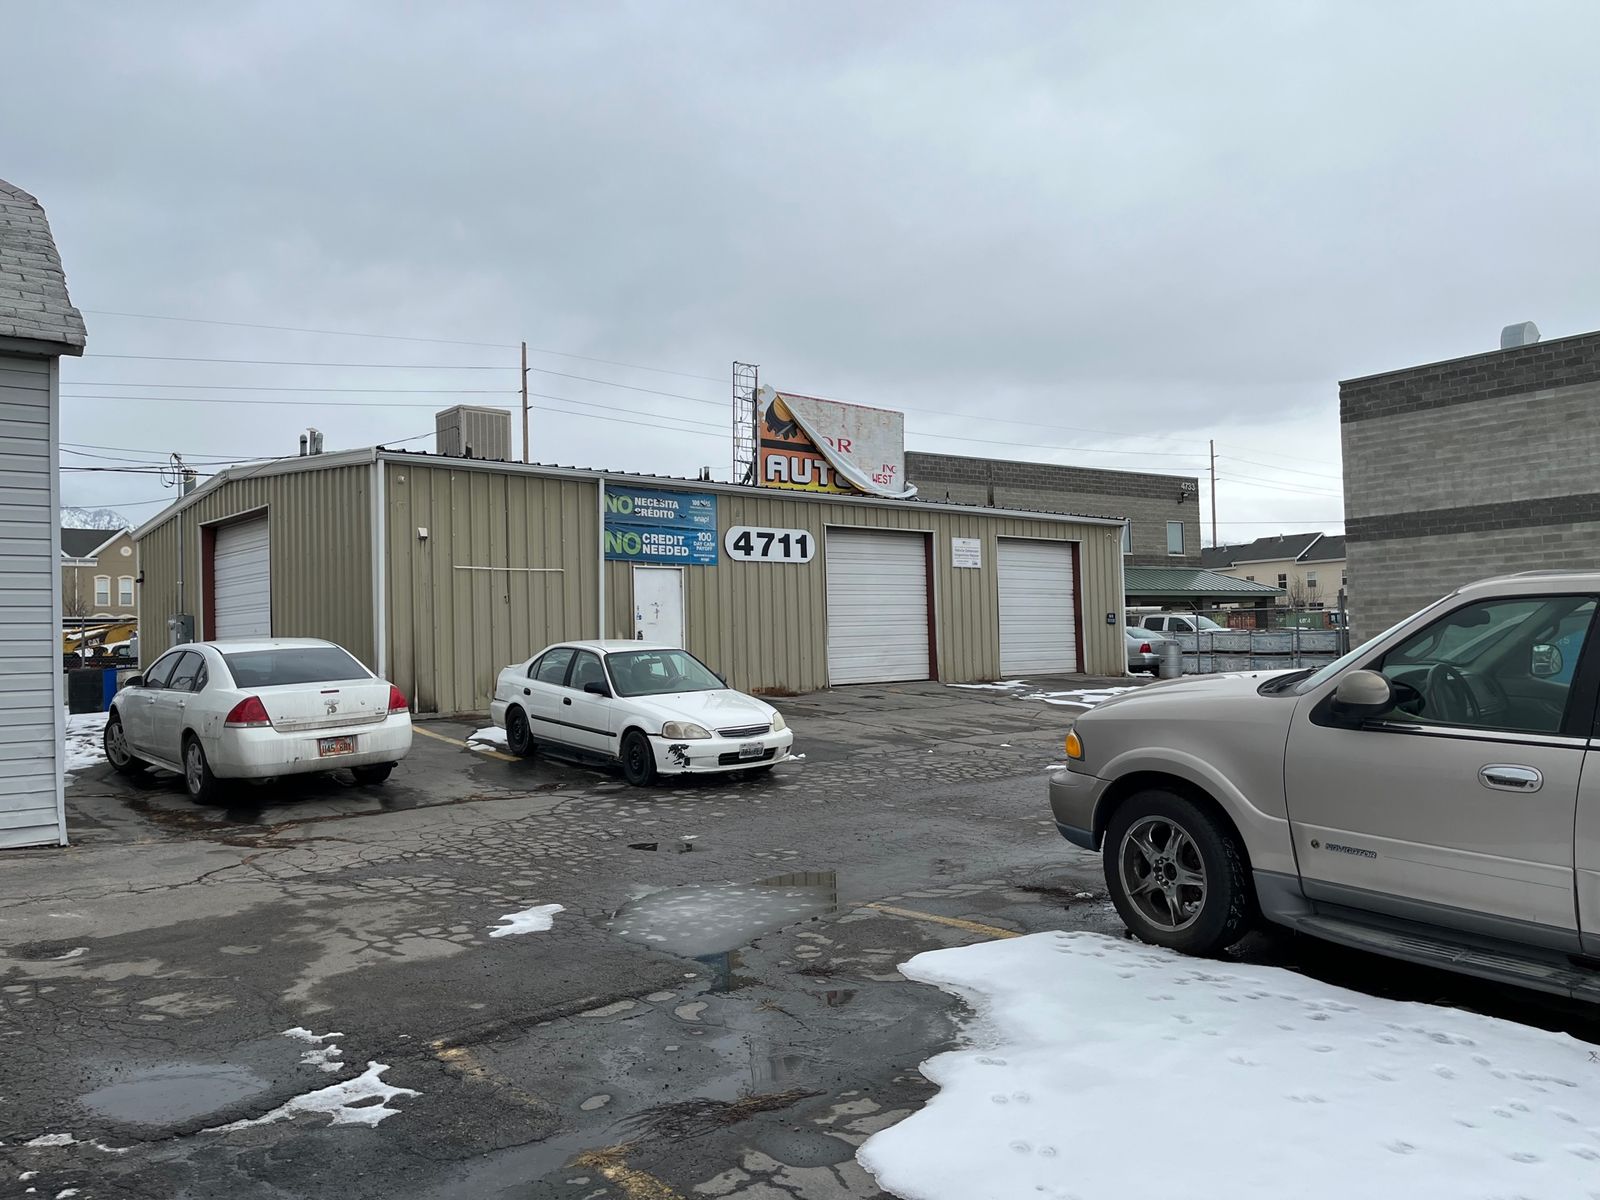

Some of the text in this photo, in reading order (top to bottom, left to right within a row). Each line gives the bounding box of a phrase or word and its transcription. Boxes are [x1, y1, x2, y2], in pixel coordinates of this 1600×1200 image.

[872, 473, 893, 485] WEST
[1181, 483, 1196, 491] 4733
[604, 494, 633, 514] NO
[634, 497, 679, 509] NECESITA
[604, 530, 641, 555] NO
[642, 533, 685, 546] CREDIT
[697, 532, 711, 541] 100
[642, 544, 689, 557] NEEDED
[733, 531, 808, 558] 4711
